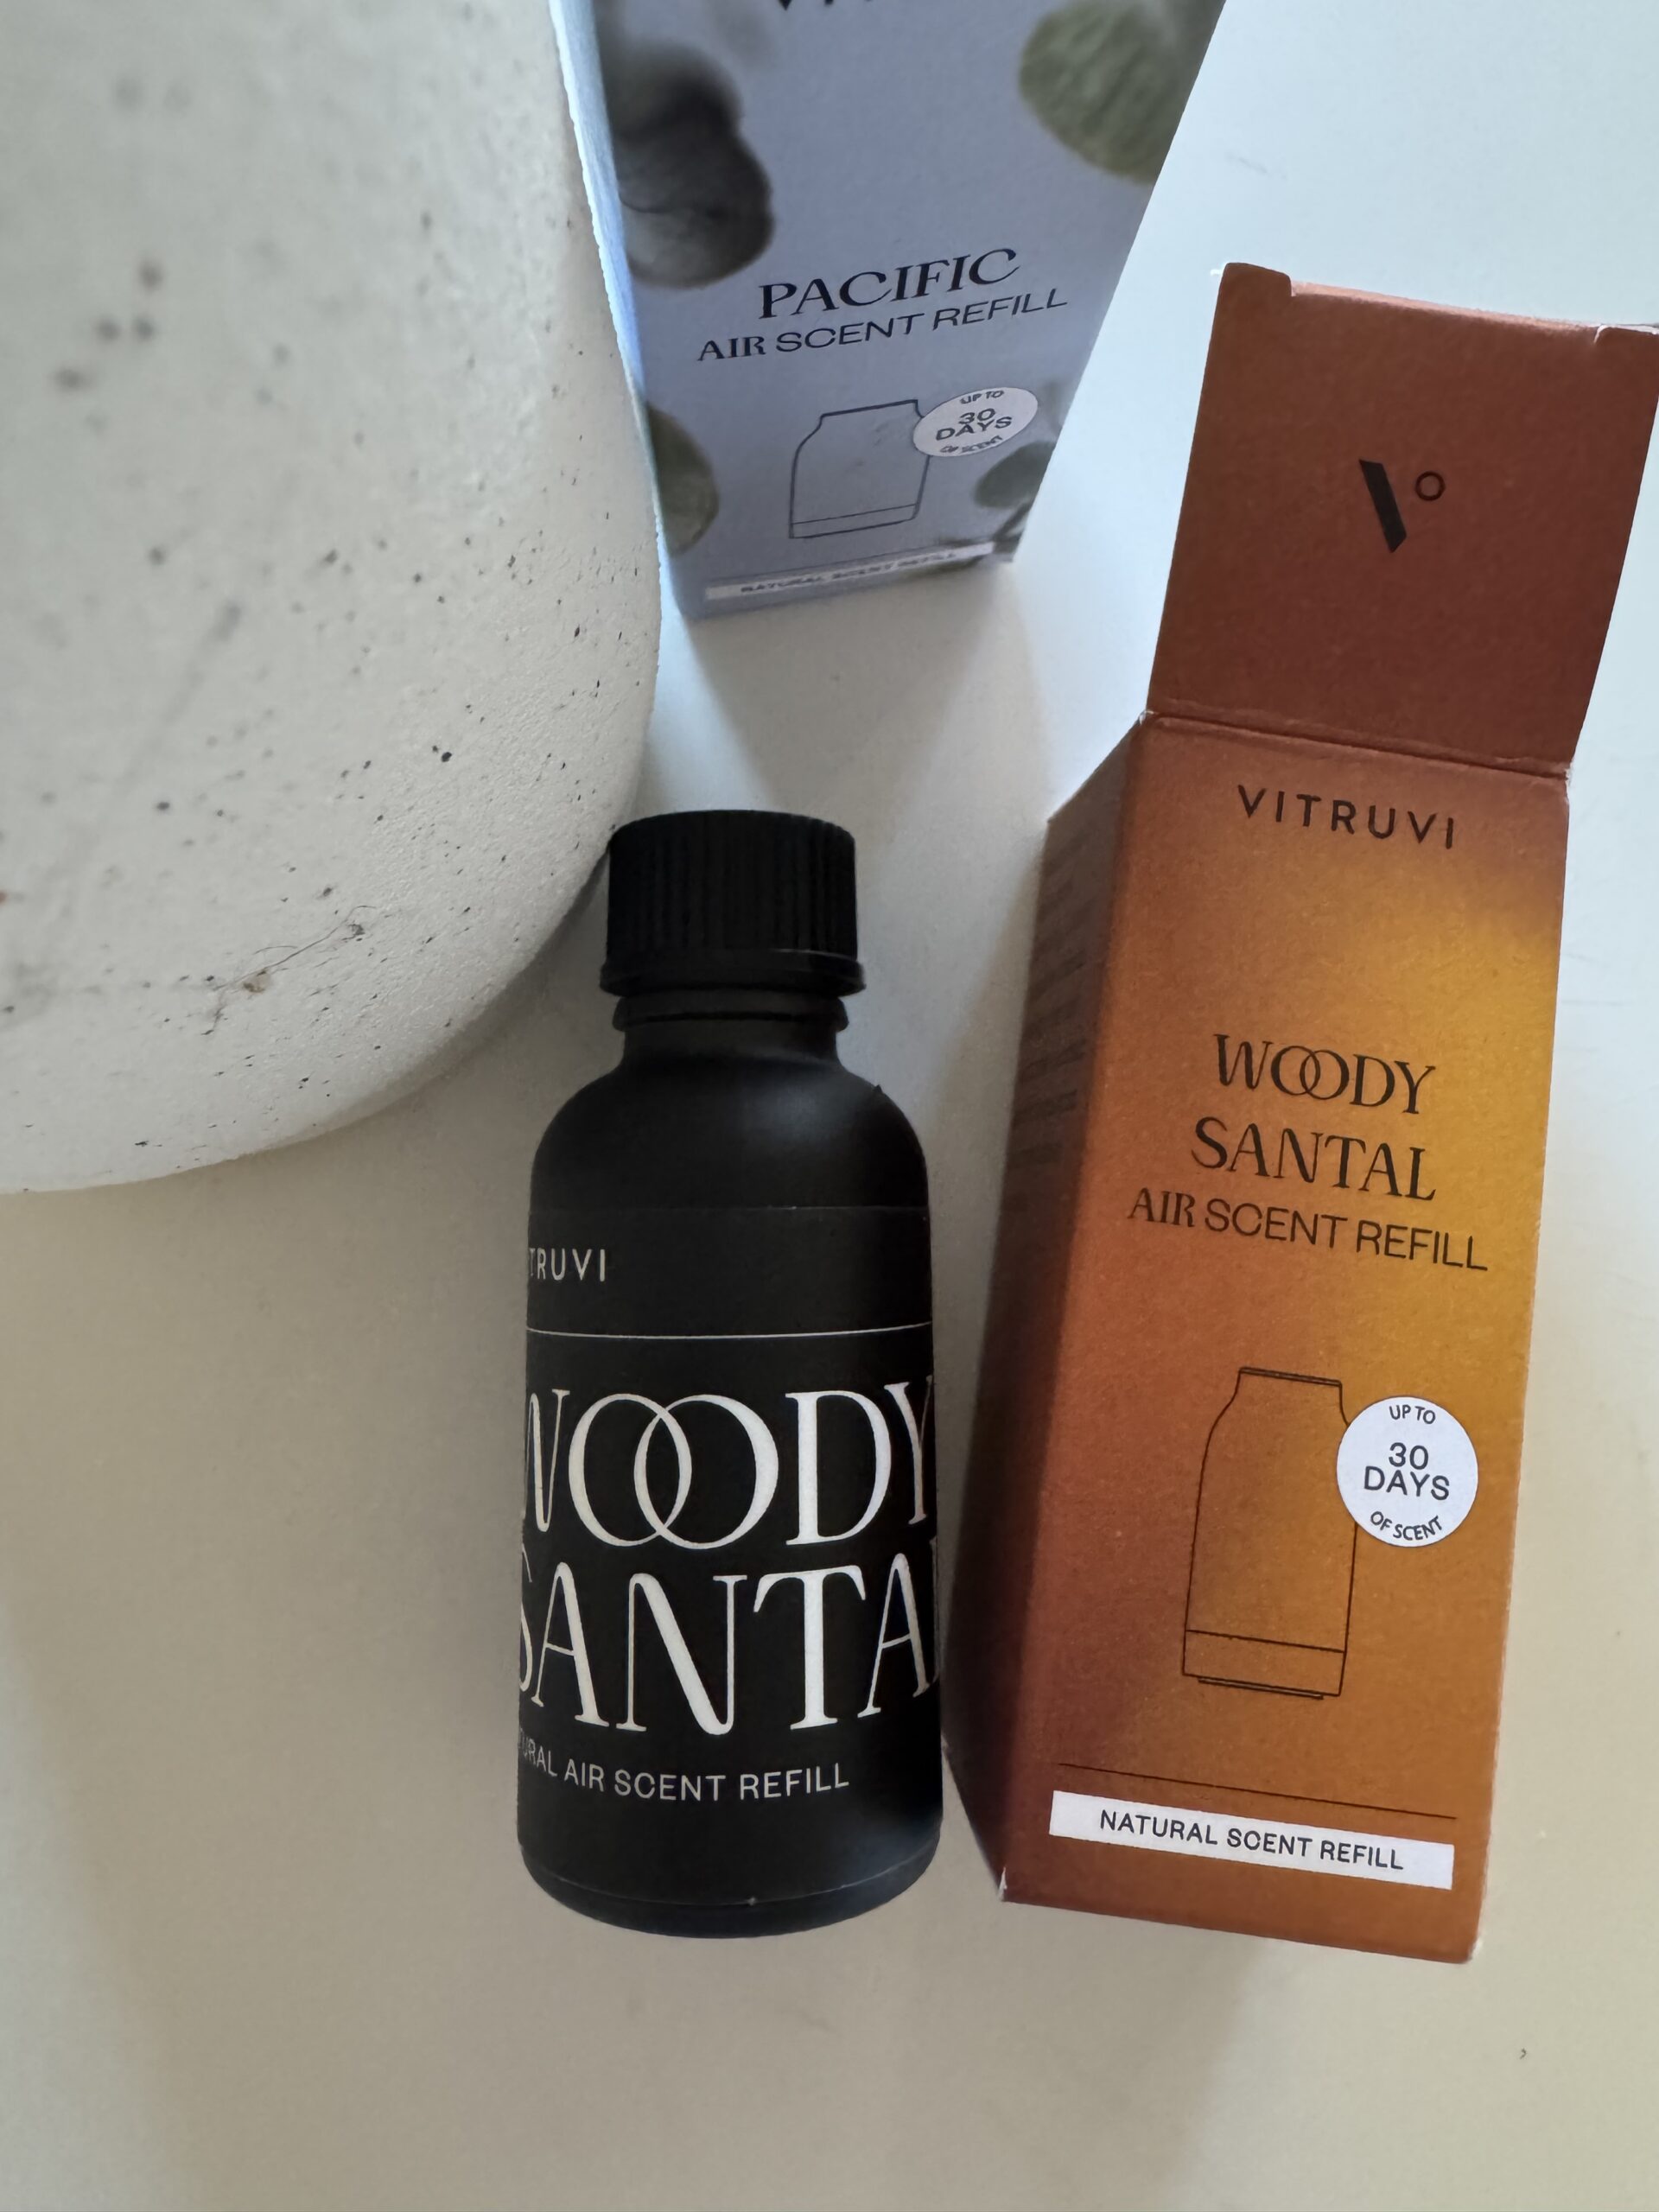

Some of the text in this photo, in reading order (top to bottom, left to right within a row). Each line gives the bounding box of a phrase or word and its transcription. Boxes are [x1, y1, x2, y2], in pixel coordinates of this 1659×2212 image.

[758, 248, 1020, 320] PACIFIC
[696, 288, 1068, 362] AIR SCENT REFILL
[935, 416, 1013, 442] DAYS
[958, 408, 996, 425] 30
[1236, 784, 1455, 849] VITRUVI
[1213, 1033, 1437, 1115] WOODY
[1191, 1116, 1437, 1202] SANTAL
[1128, 1187, 1489, 1272] AIR SCENT REFILL
[529, 1247, 606, 1282] TRUVI
[1389, 1404, 1436, 1425] UP TO
[1389, 1442, 1429, 1470] 30
[1363, 1465, 1450, 1501] DAYS
[1370, 1510, 1443, 1541] OF SCENT
[563, 1758, 605, 1792] AIR
[614, 1769, 727, 1802] SCENT
[739, 1762, 850, 1802] REFILL
[1100, 1808, 1404, 1871] NATURAL SCENT REFILL
